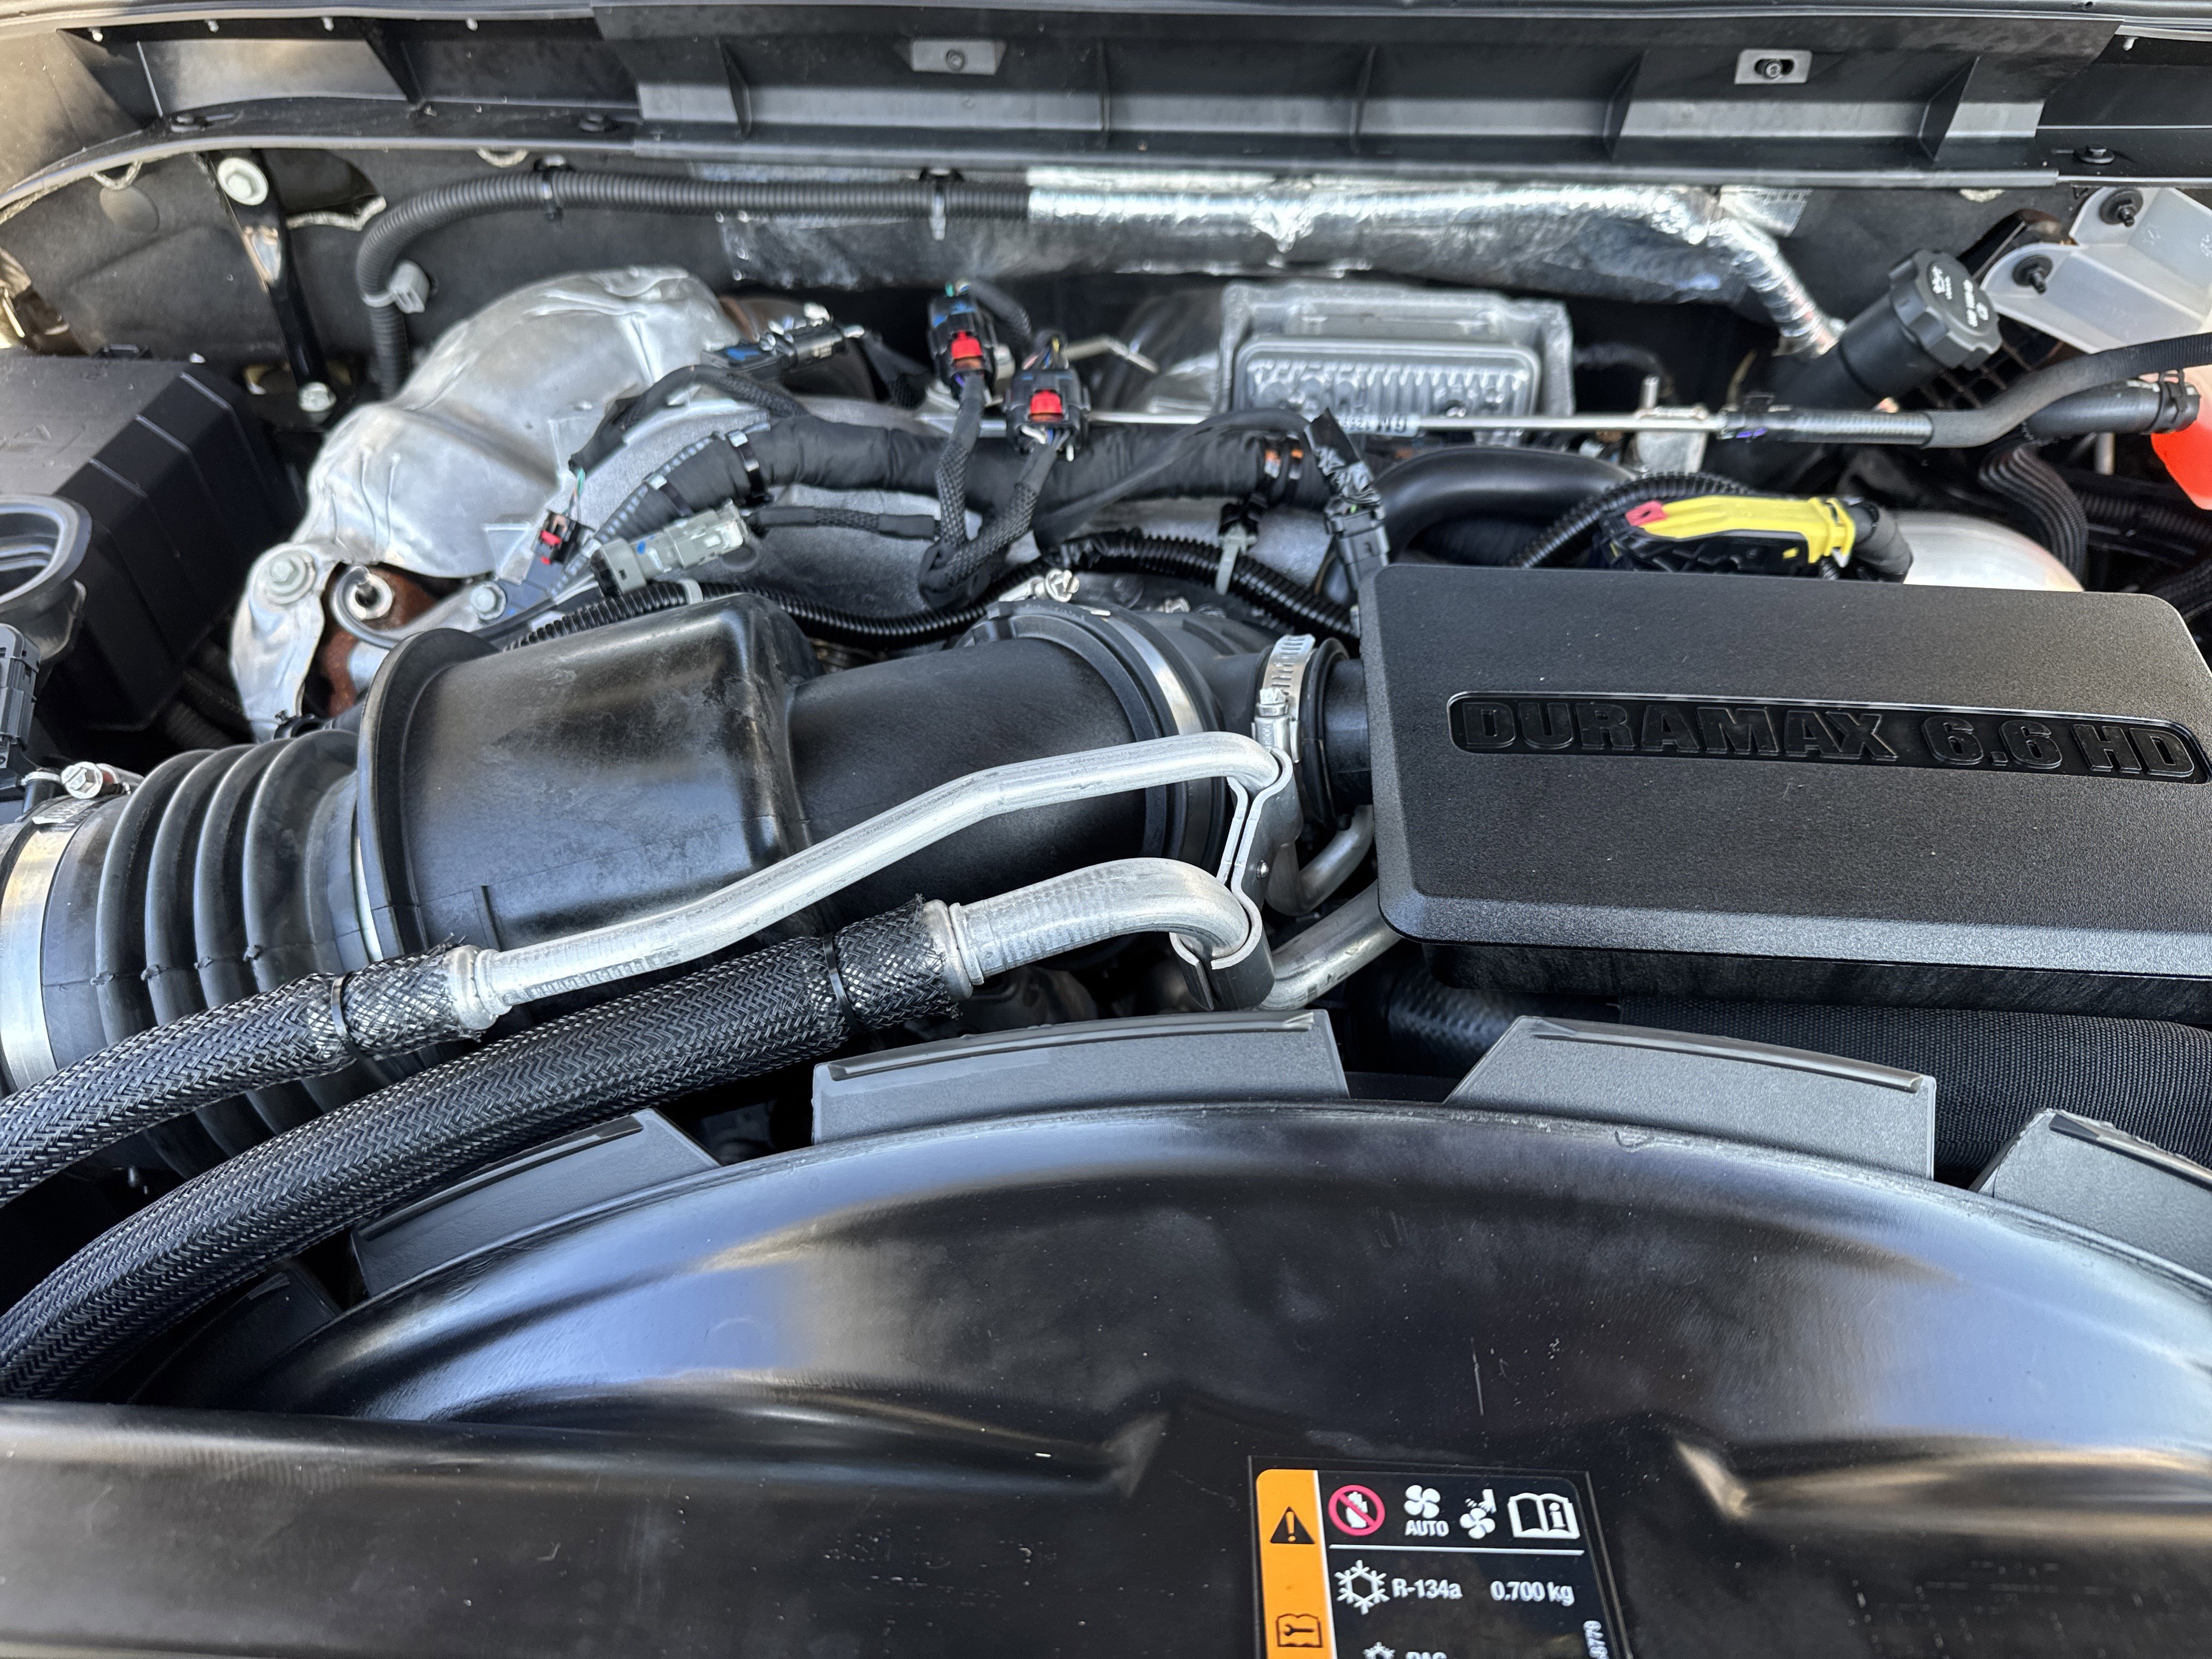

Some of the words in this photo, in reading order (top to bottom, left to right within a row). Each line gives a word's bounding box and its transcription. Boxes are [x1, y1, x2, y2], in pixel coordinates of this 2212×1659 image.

[1462, 702, 1899, 760] DURAMAX
[1921, 715, 2062, 769] 6.6
[2073, 724, 2194, 778] HD
[1405, 1520, 1449, 1536] AUTO
[1391, 1578, 1463, 1600] R-134a
[1490, 1581, 1545, 1601] 0.700
[1548, 1582, 1575, 1606] kg
